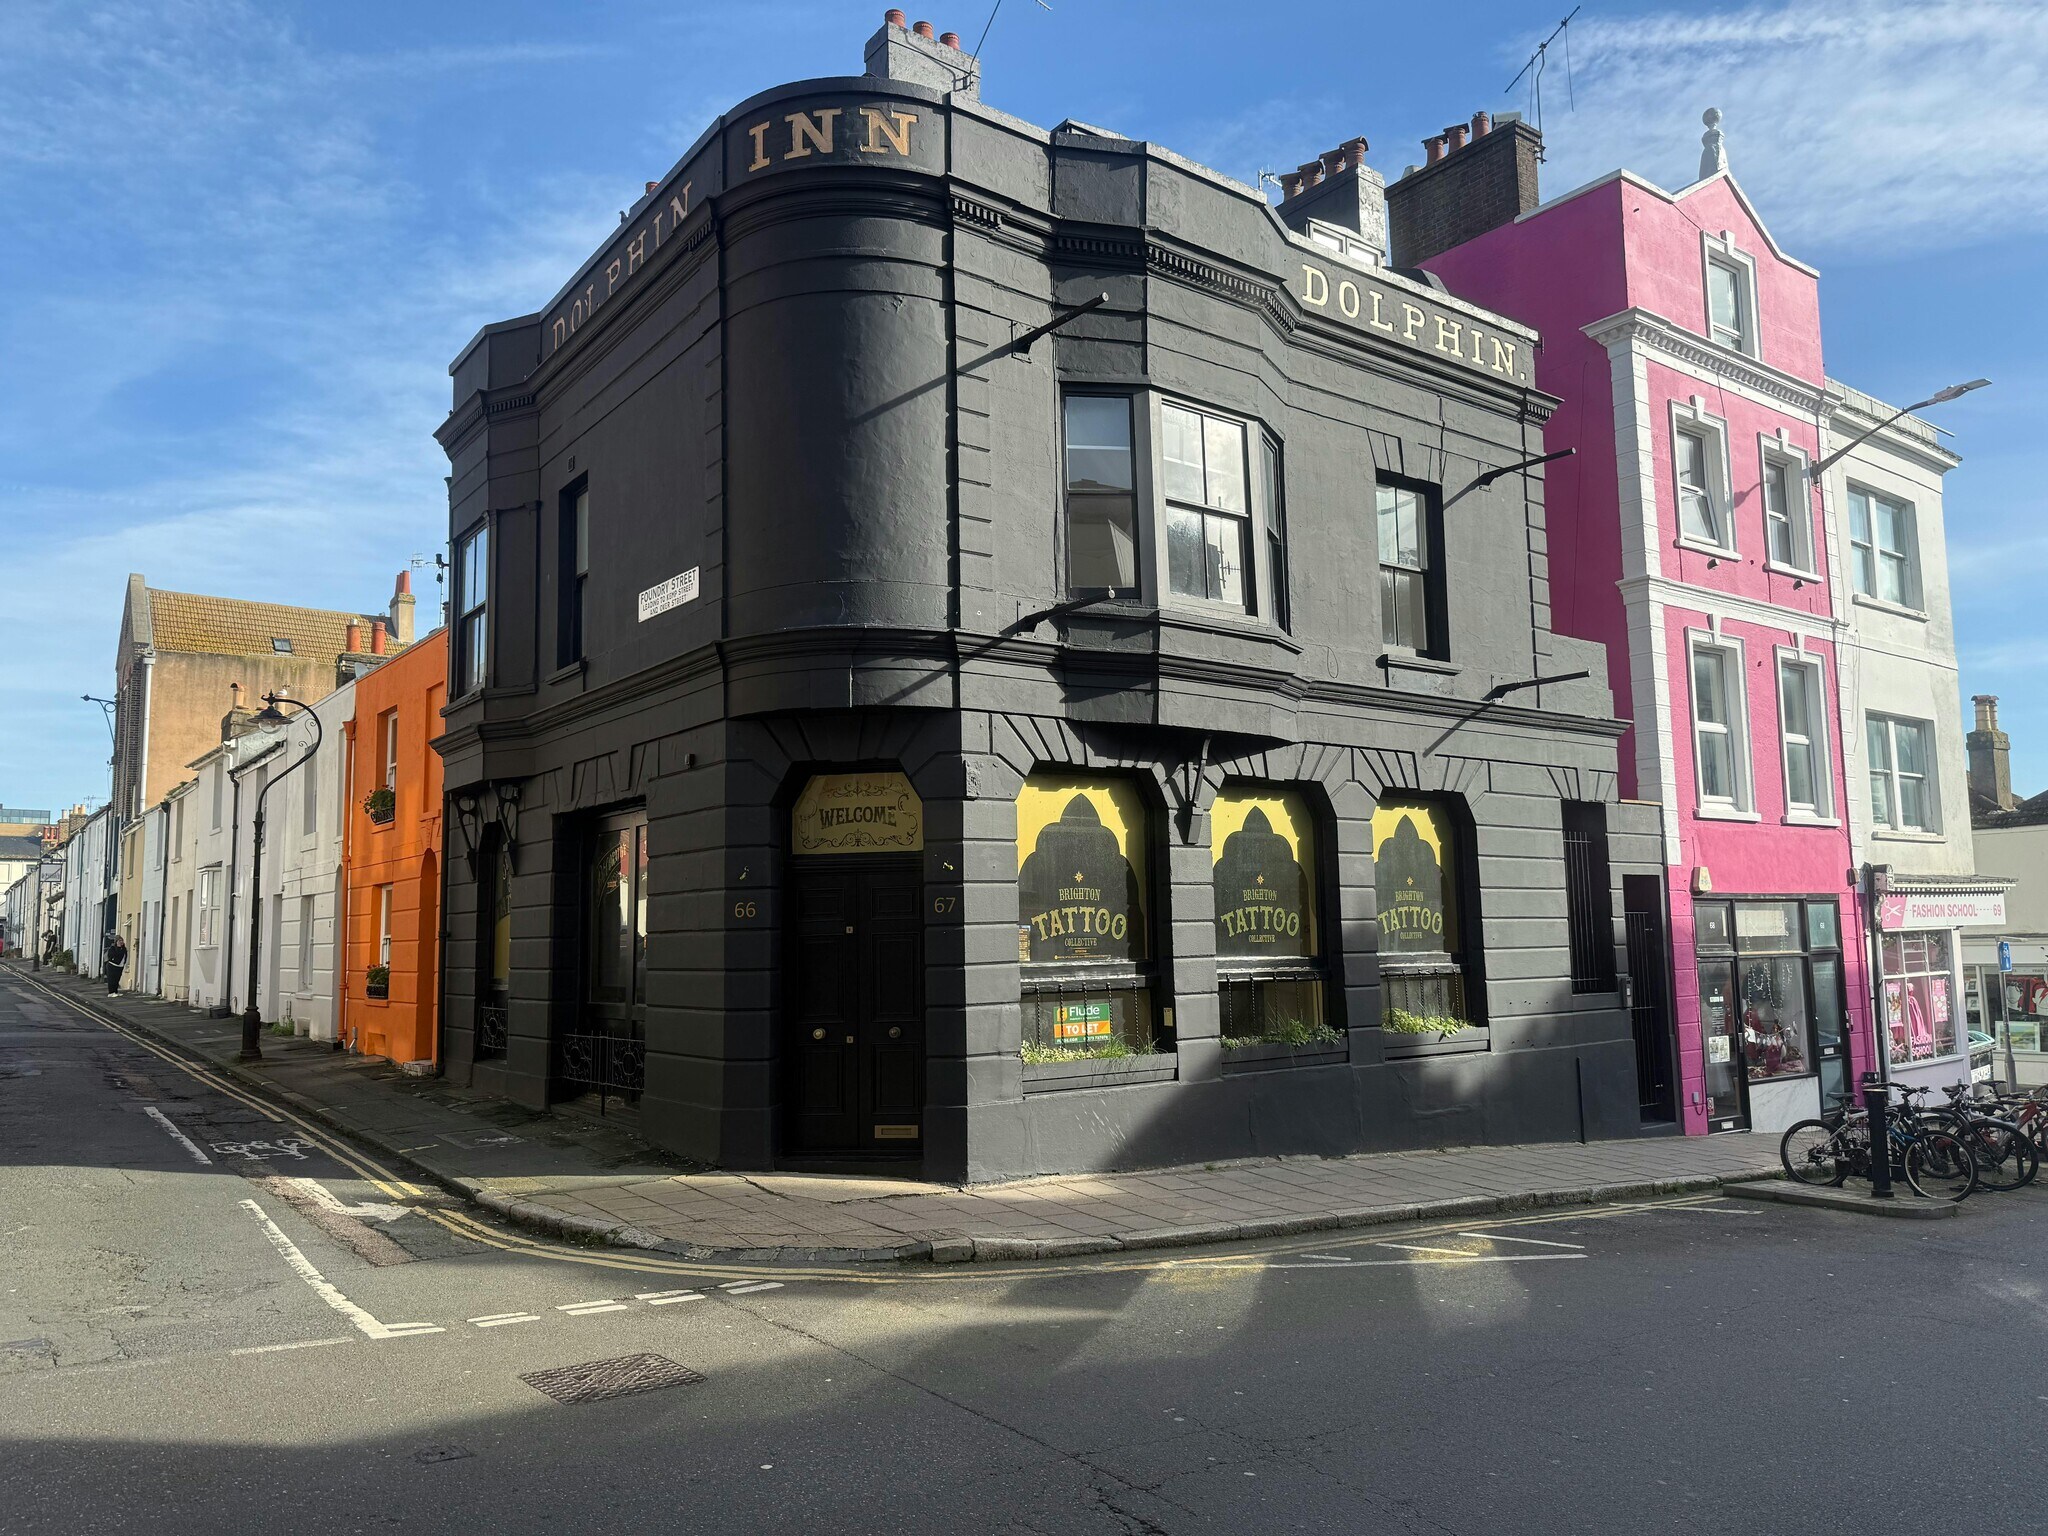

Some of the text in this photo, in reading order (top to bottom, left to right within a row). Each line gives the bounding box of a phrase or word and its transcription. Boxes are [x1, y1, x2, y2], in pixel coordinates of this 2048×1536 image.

[748, 107, 918, 172] INN
[640, 569, 697, 604] FOUNDRY STREET
[642, 598, 660, 611] LEADING
[660, 595, 666, 603] TO
[678, 582, 694, 595] STREET
[650, 606, 659, 615] AND
[671, 594, 687, 606] STREET
[819, 805, 897, 829] WELCOME
[1059, 888, 1101, 901] BRIGHTON
[1243, 889, 1278, 901] BRIGHTON
[1395, 890, 1424, 902] BRIGHTON
[734, 902, 756, 918] 66
[934, 897, 956, 913] 67
[1912, 904, 2002, 918] FASHION SCHOOL 69
[1031, 906, 1127, 941] TATTOO
[1220, 906, 1300, 937] TATTOO
[1377, 906, 1443, 934] TATTOO
[1064, 938, 1098, 947] COLLECTIVE
[1248, 935, 1276, 943] COLLECTIVE
[1069, 1005, 1100, 1017] Flude
[1066, 1023, 1099, 1035] TO LET
[1912, 1045, 1933, 1057] SCHOOL
